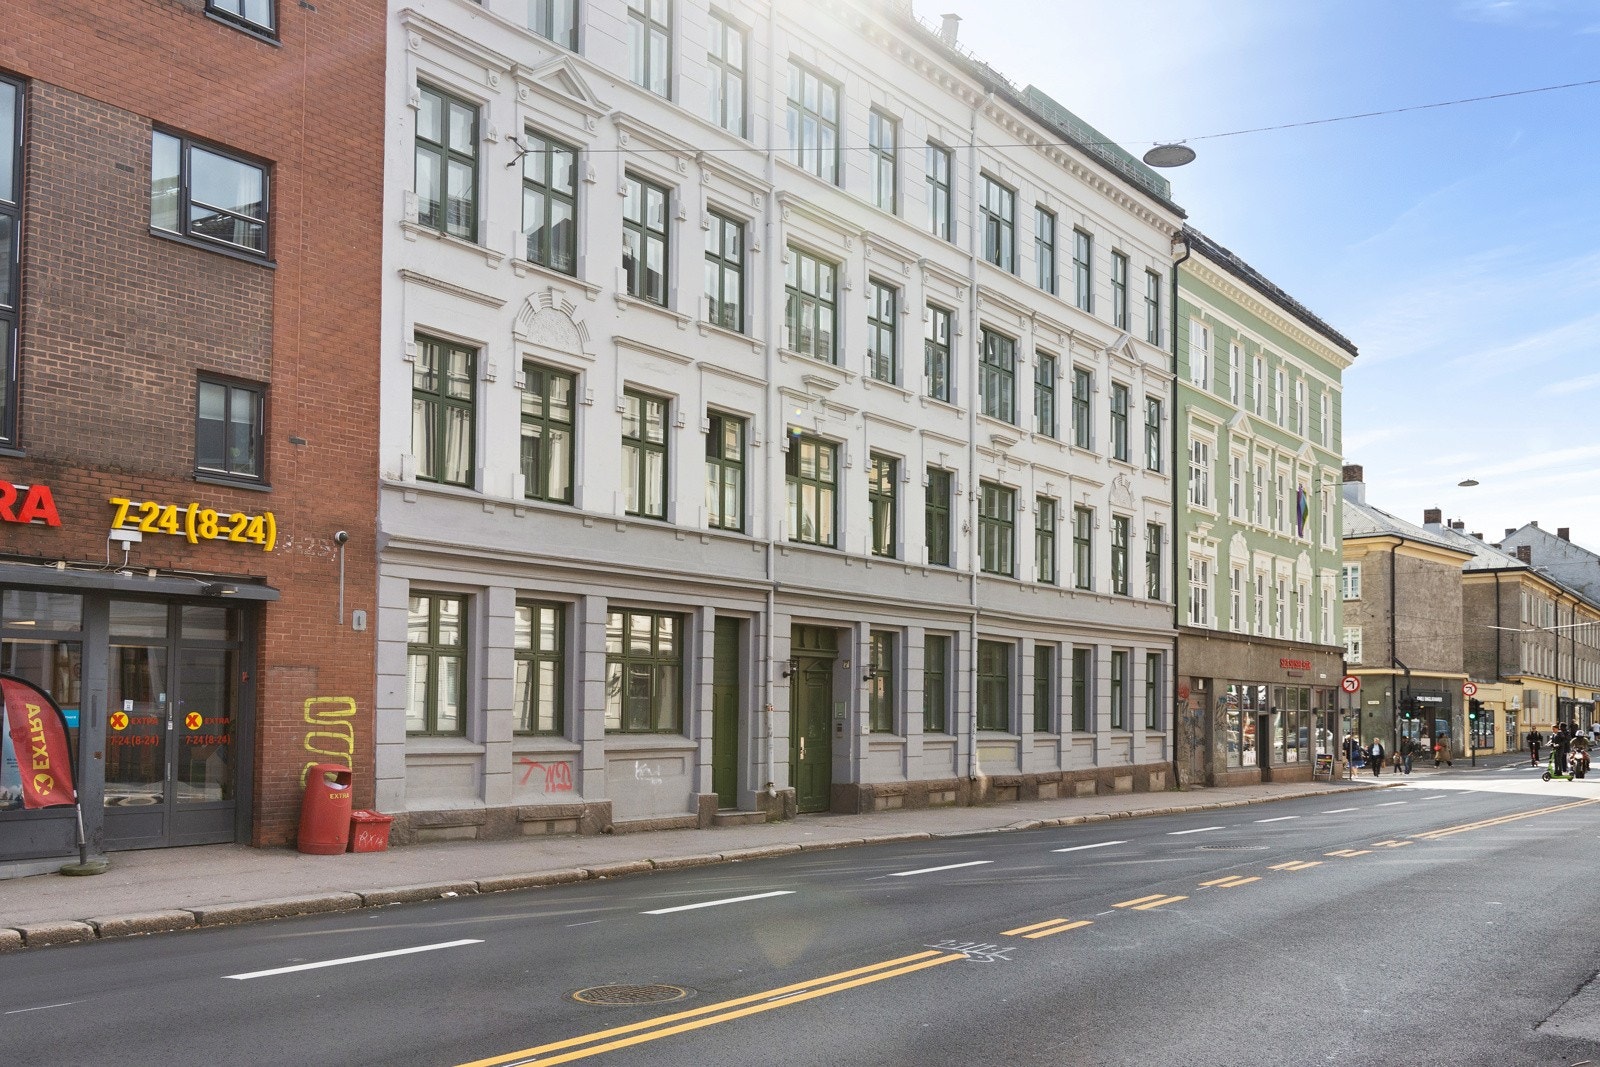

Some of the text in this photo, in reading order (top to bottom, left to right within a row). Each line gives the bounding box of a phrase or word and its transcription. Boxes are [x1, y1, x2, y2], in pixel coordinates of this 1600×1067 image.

[109, 497, 180, 535] 7-24
[185, 502, 277, 552] (8-24)
[130, 717, 158, 725] EXTRA
[204, 717, 230, 725] EXTRA
